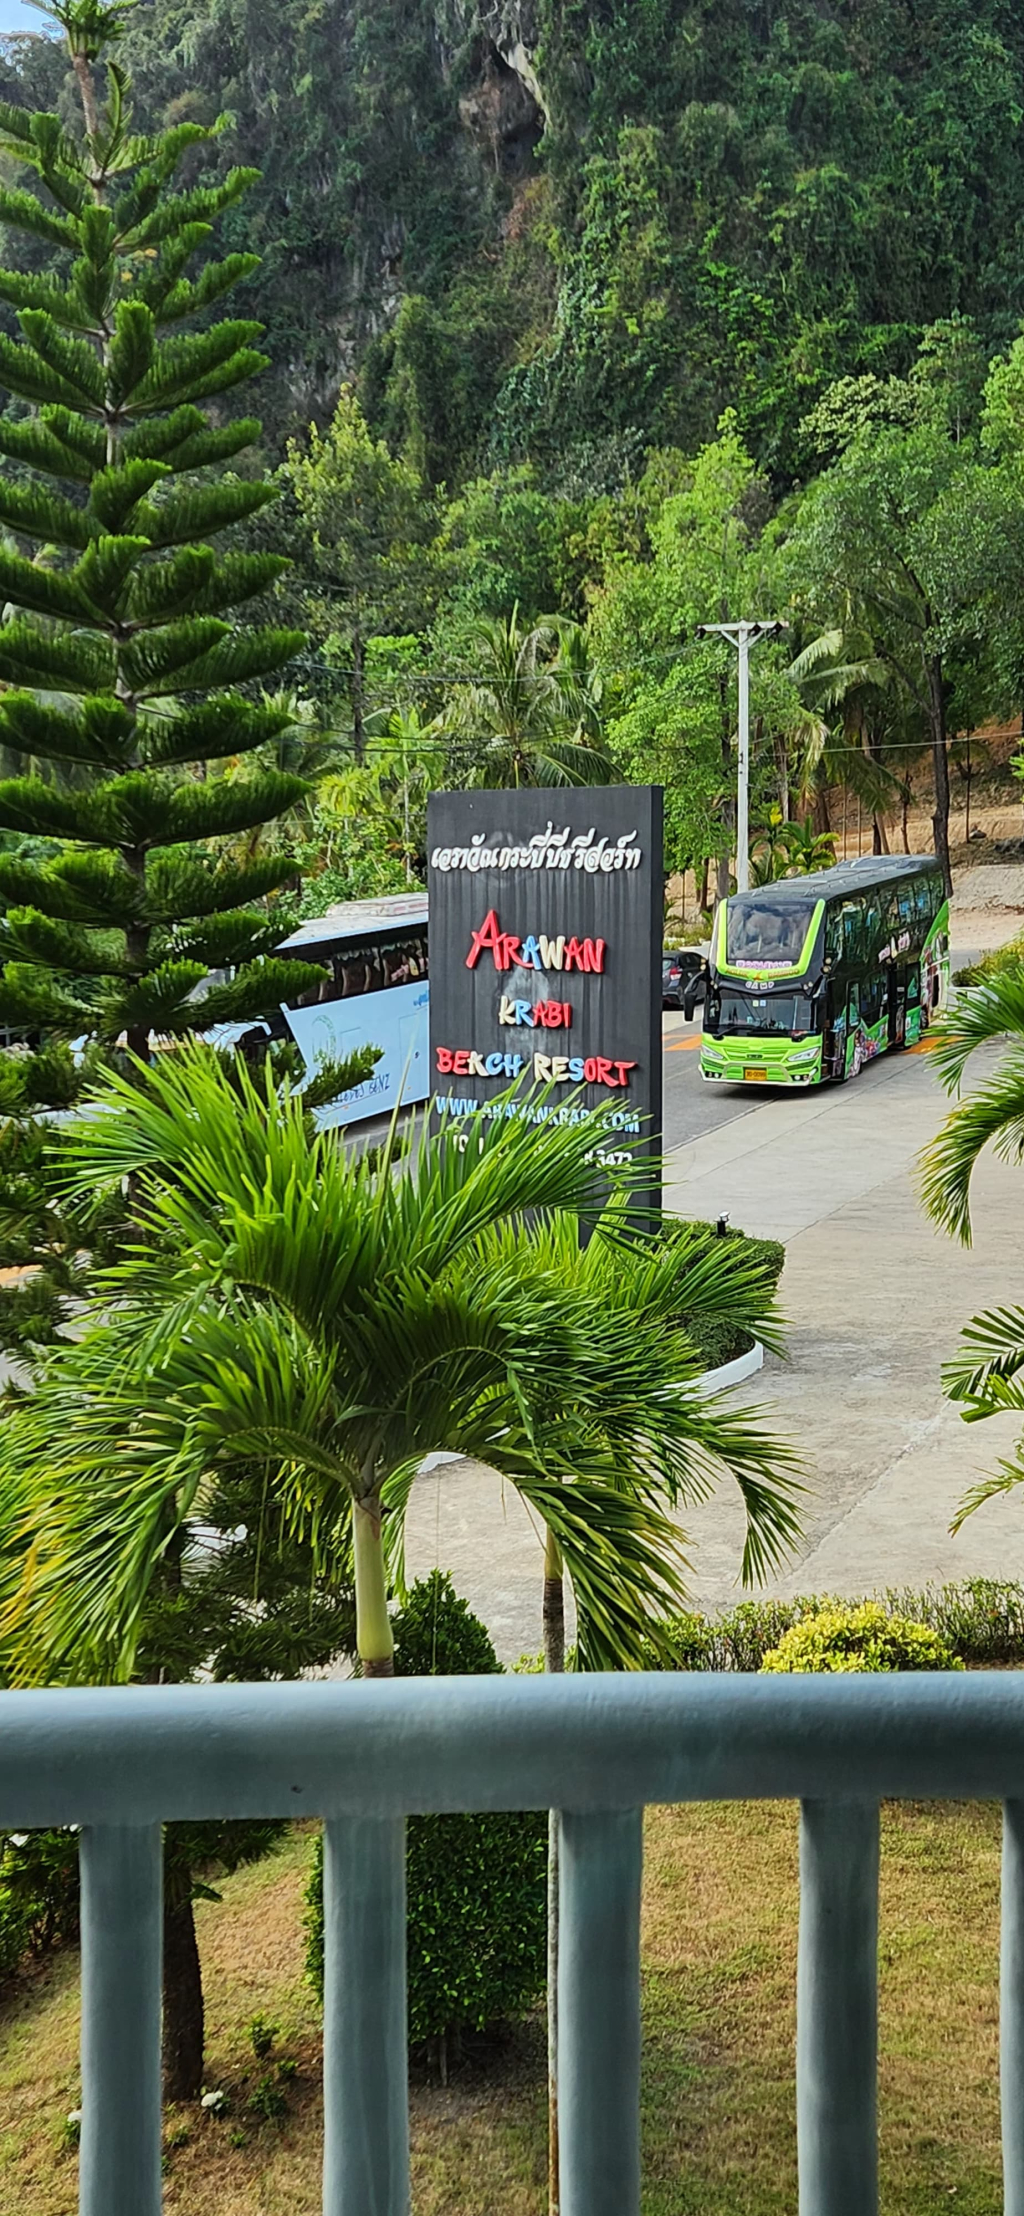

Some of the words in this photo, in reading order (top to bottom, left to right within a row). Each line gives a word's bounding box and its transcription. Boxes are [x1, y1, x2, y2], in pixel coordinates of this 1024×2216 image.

[499, 995, 571, 1028] KRABI
[533, 1052, 638, 1087] RESORT
[435, 1096, 640, 1133] WWWARAWNKRAB.COM
